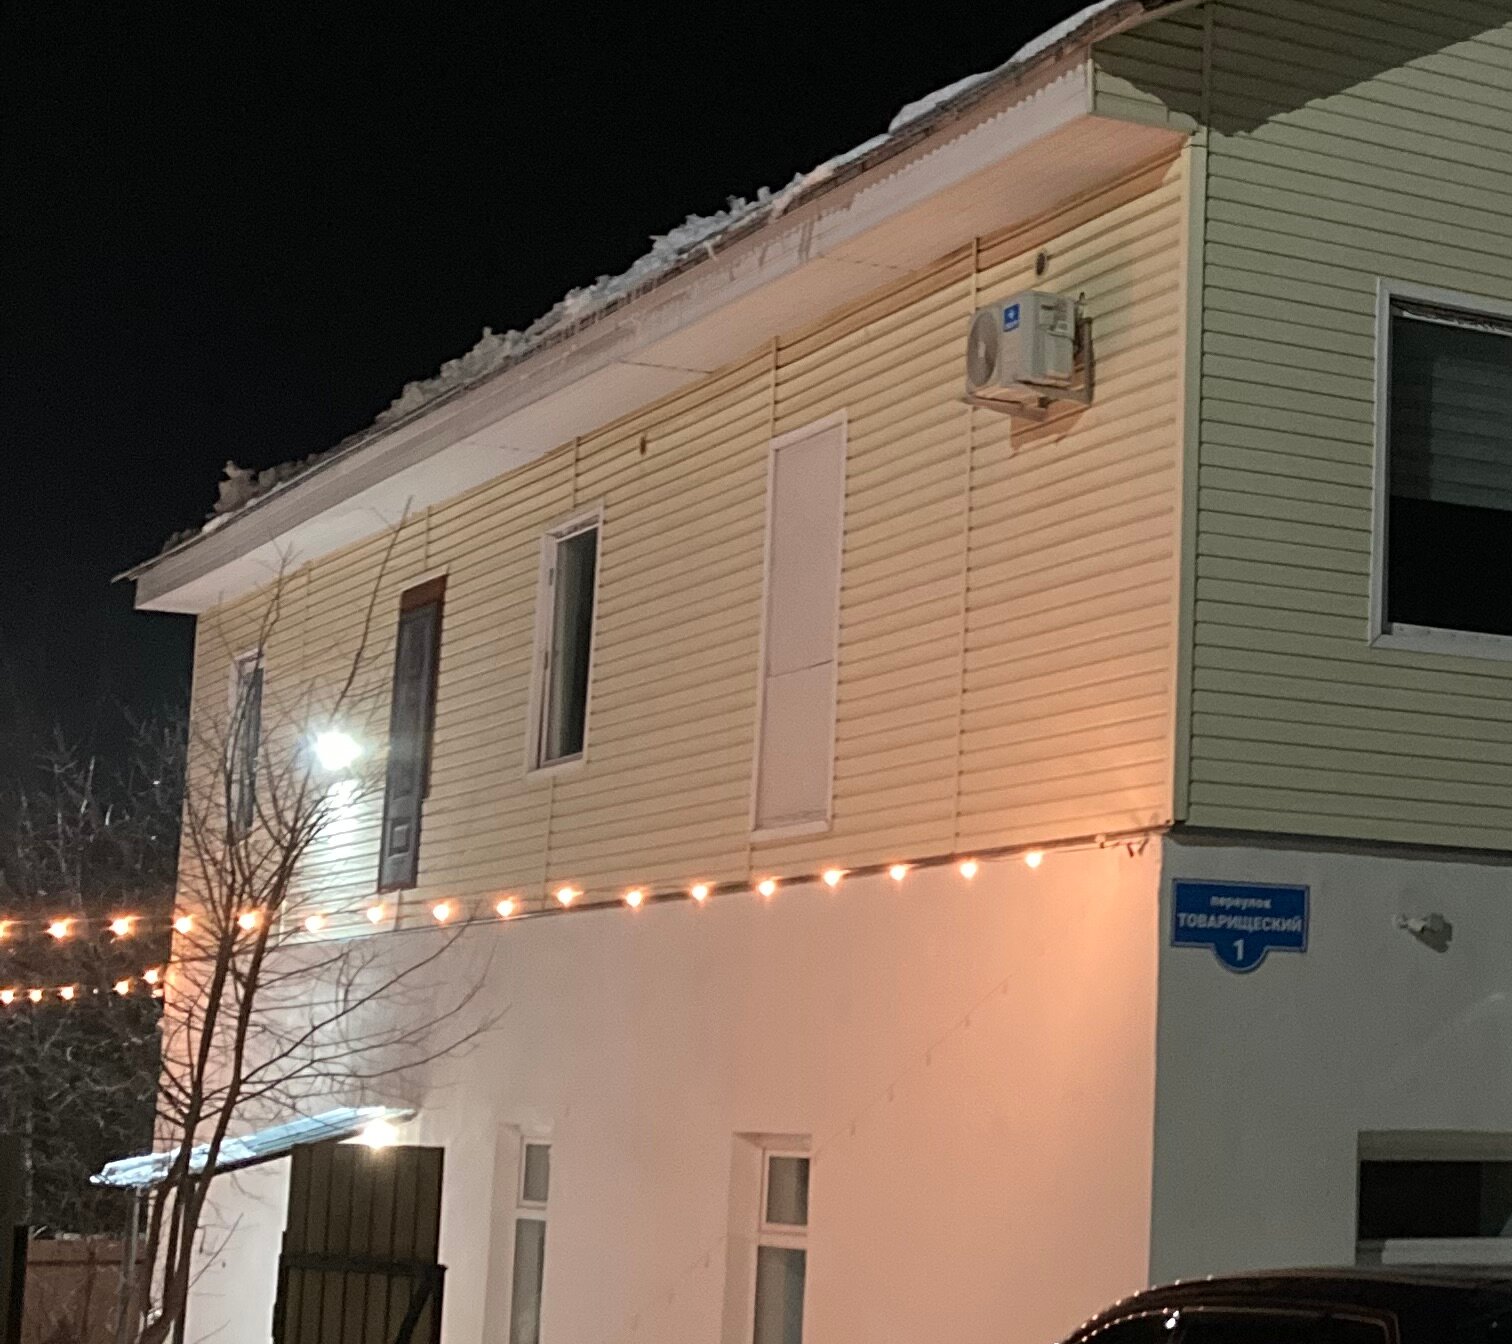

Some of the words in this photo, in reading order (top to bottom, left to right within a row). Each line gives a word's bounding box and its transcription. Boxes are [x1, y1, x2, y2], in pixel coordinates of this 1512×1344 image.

[1210, 896, 1272, 910] переулок
[1177, 912, 1302, 932] ТОВАРИЩЕСКИЙ
[1233, 938, 1245, 961] 1
